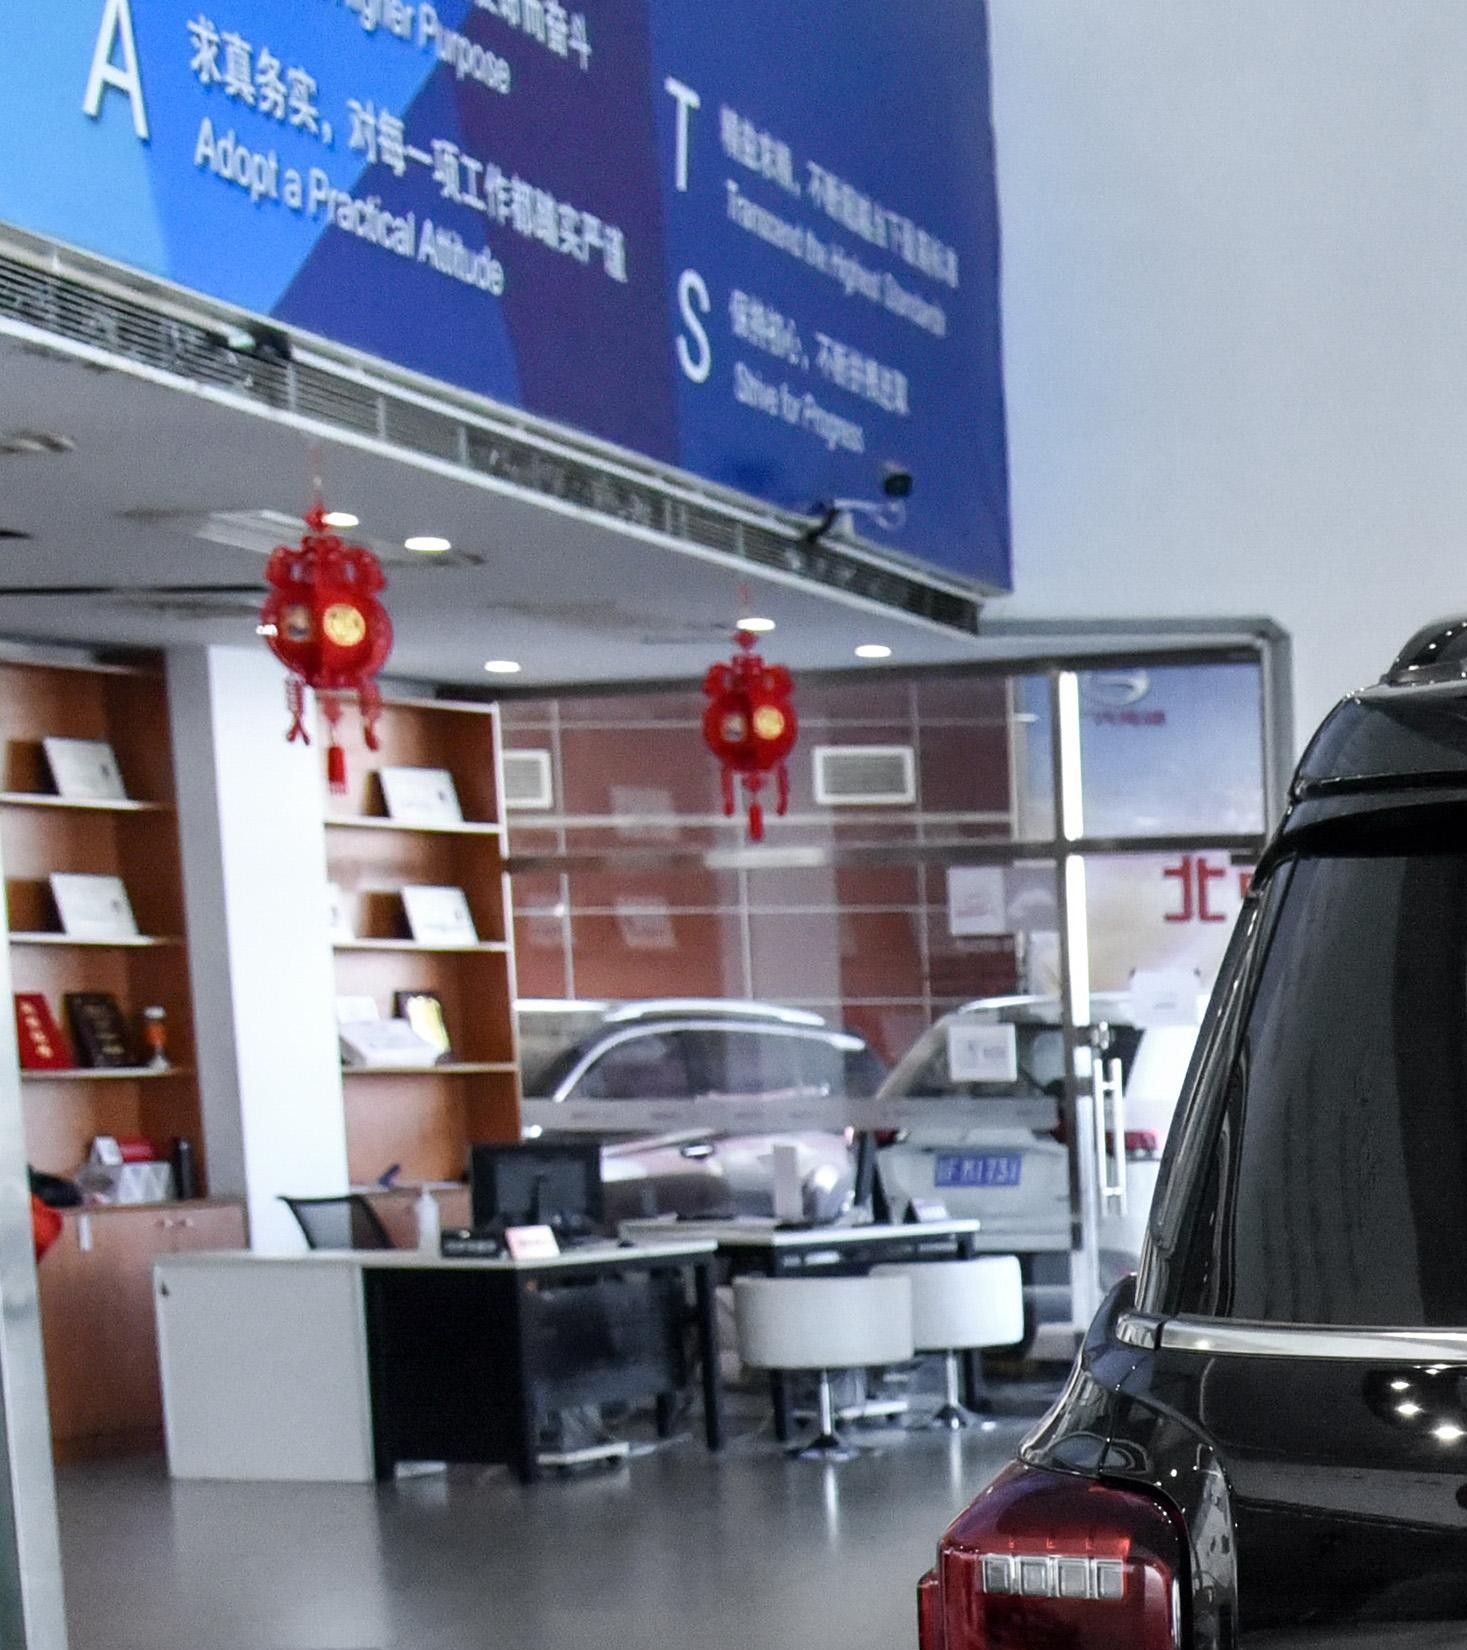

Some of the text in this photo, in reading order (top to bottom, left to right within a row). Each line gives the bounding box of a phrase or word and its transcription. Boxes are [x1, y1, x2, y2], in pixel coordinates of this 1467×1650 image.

[82, 0, 149, 141] A
[416, 3, 511, 94] Purpose
[664, 76, 700, 192] T
[194, 117, 504, 297] Adopt a Practical Attitude
[677, 268, 711, 384] S
